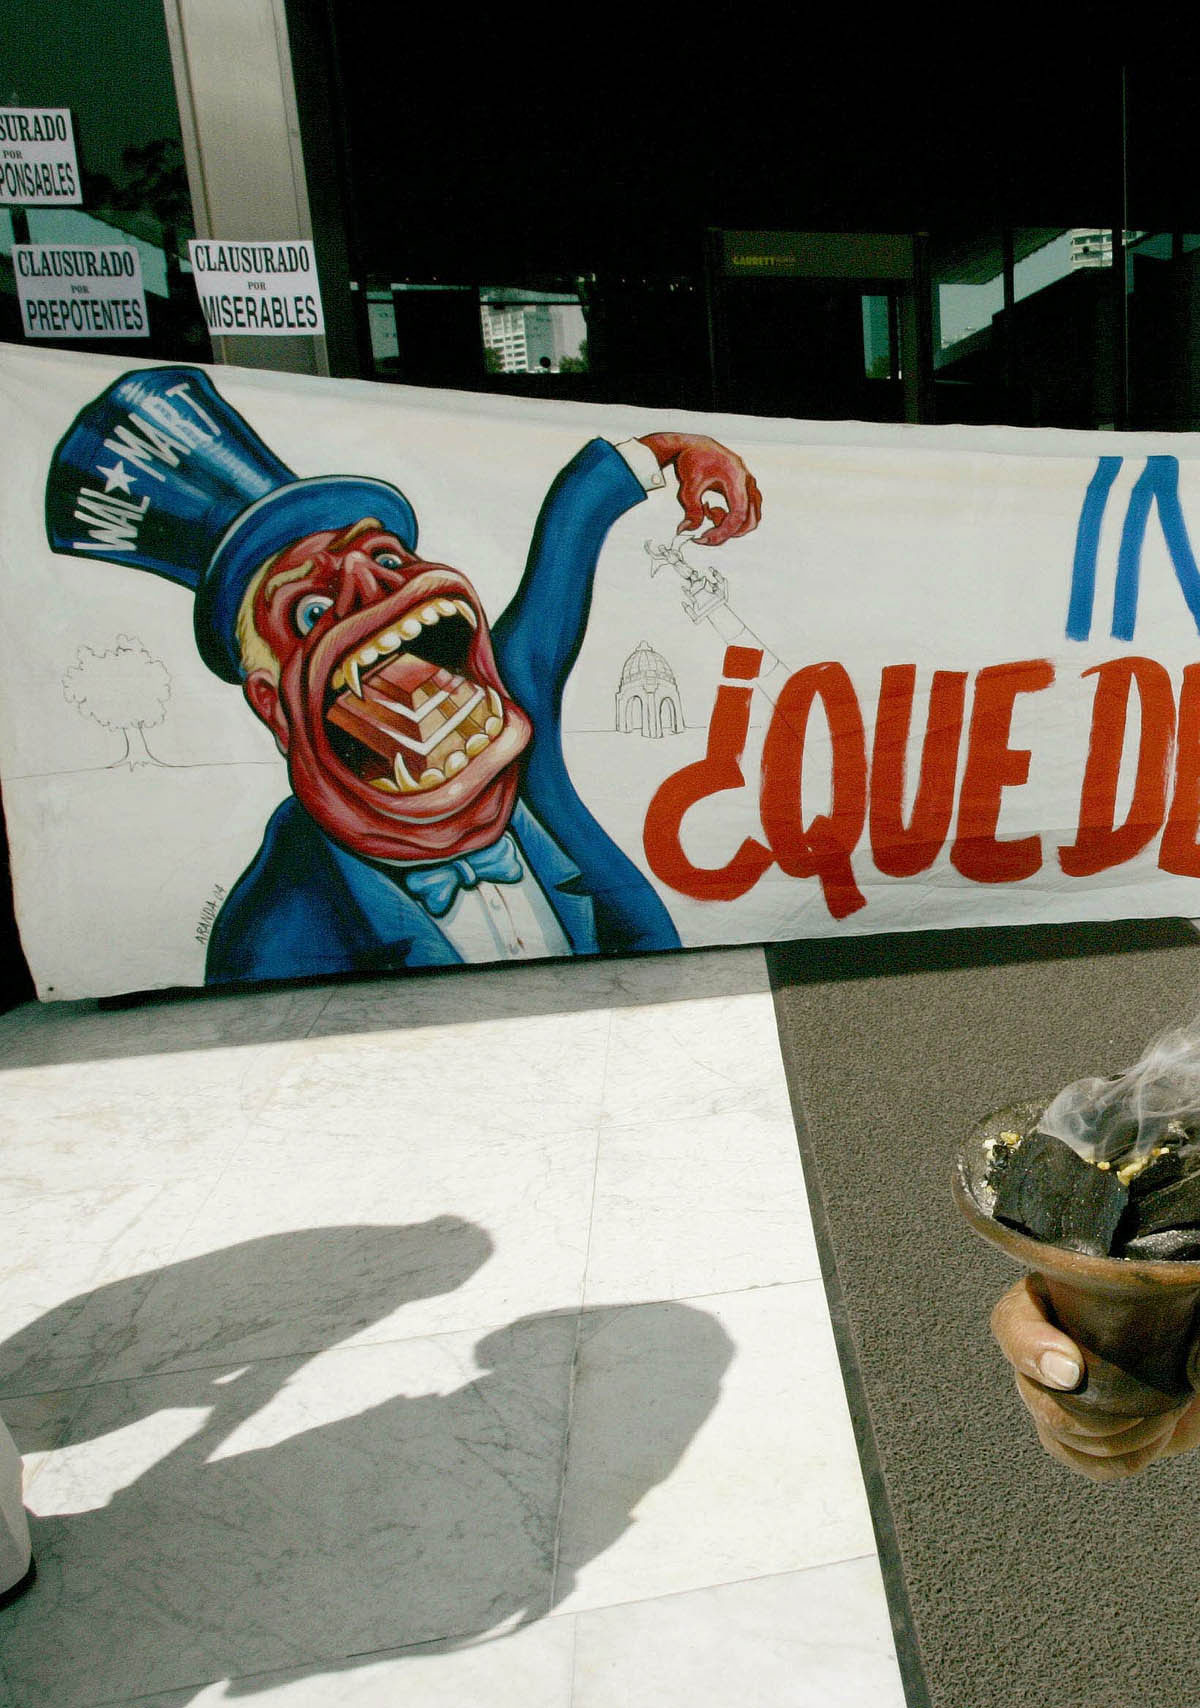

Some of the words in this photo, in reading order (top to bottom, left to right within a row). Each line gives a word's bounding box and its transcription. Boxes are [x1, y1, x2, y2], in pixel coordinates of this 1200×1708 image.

[3, 150, 23, 159] POR
[18, 250, 135, 277] CLAUSURADO
[195, 245, 310, 273] CLAUSURADO
[71, 284, 90, 294] POR
[248, 281, 267, 291] POR
[26, 299, 143, 331] PREPOTENTES
[202, 295, 318, 329] MISERABLES
[642, 646, 1057, 920] ¿QUE
